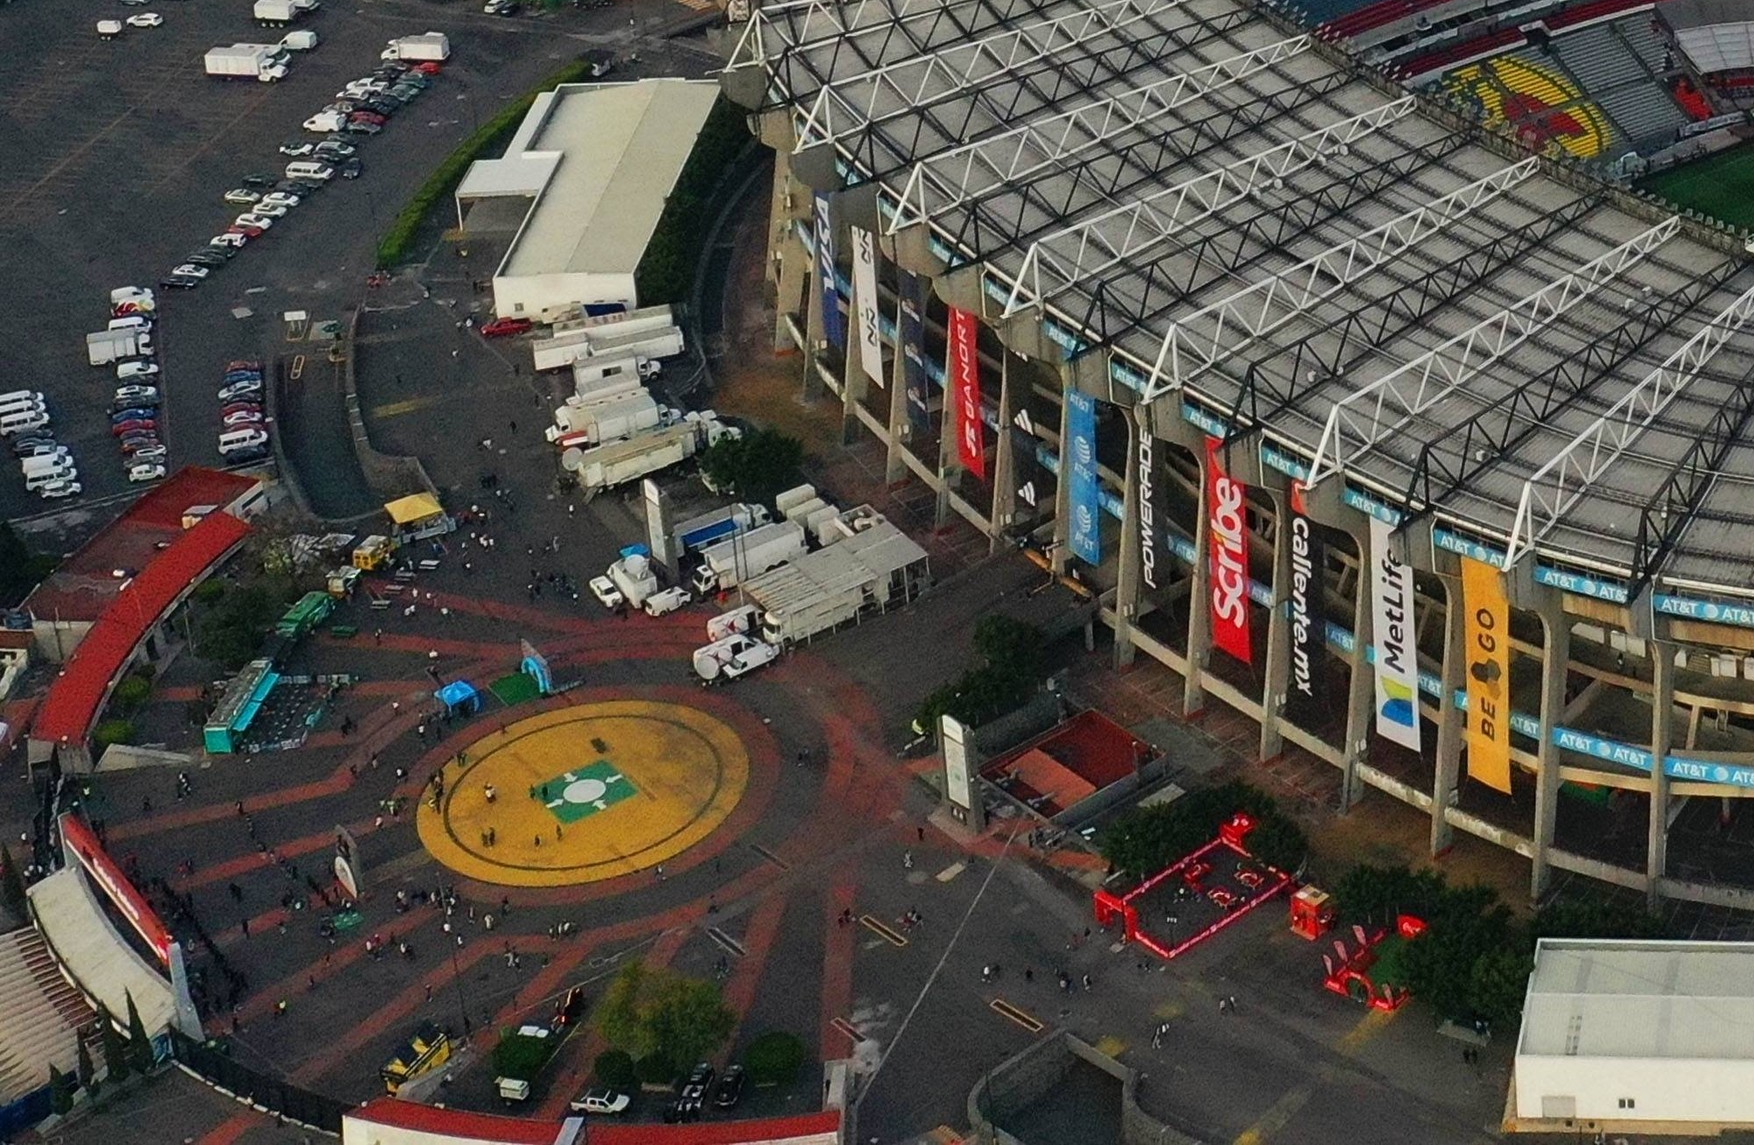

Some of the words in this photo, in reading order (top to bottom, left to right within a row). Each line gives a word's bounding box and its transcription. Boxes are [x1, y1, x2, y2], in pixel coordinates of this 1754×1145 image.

[955, 308, 976, 420] BANORT
[1189, 410, 1213, 429] AT&T
[1265, 452, 1291, 472] AT&T
[1139, 429, 1157, 590] POWERADE
[1351, 494, 1376, 515] AT&T
[1440, 535, 1470, 555] AT&T
[1544, 570, 1577, 590] AT&T
[1600, 587, 1628, 604] AT&
[1292, 517, 1312, 697] caliente.mx
[1382, 548, 1405, 674] MetLife
[1661, 597, 1698, 615] AT&T
[1476, 608, 1496, 653] GO
[1511, 714, 1539, 735] AT&T
[1559, 734, 1592, 750] AT&T
[1613, 748, 1647, 765] AT&T
[1672, 761, 1708, 777] AT&T
